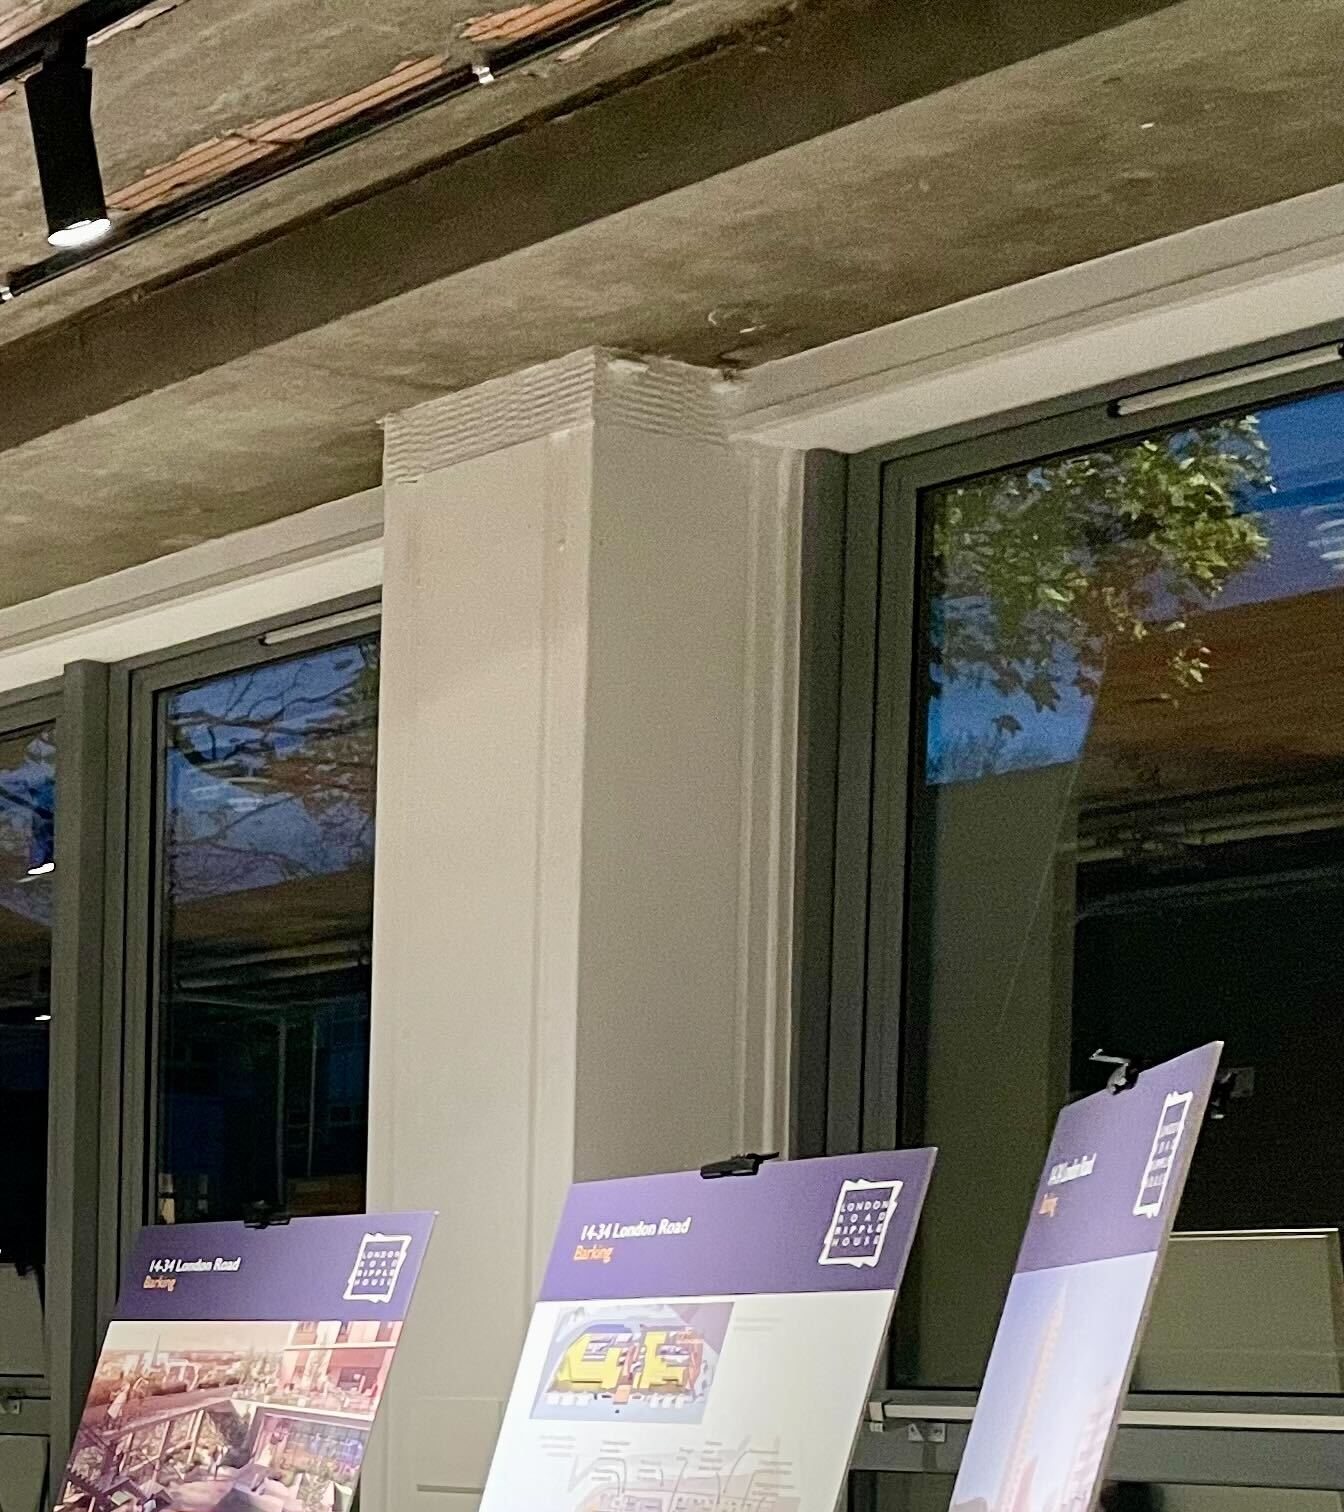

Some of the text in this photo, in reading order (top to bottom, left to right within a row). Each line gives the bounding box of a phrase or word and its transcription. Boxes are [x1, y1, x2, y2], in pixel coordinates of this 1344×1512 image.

[841, 1200, 889, 1212] LONDON
[837, 1212, 886, 1224] ROAD
[581, 1216, 692, 1241] 14-34 London Road
[834, 1223, 883, 1236] RIPPLE
[831, 1235, 880, 1247] HOUSE
[573, 1244, 613, 1264] Barking
[149, 1256, 242, 1273] 14-34 London Road
[143, 1275, 176, 1291] Barking
